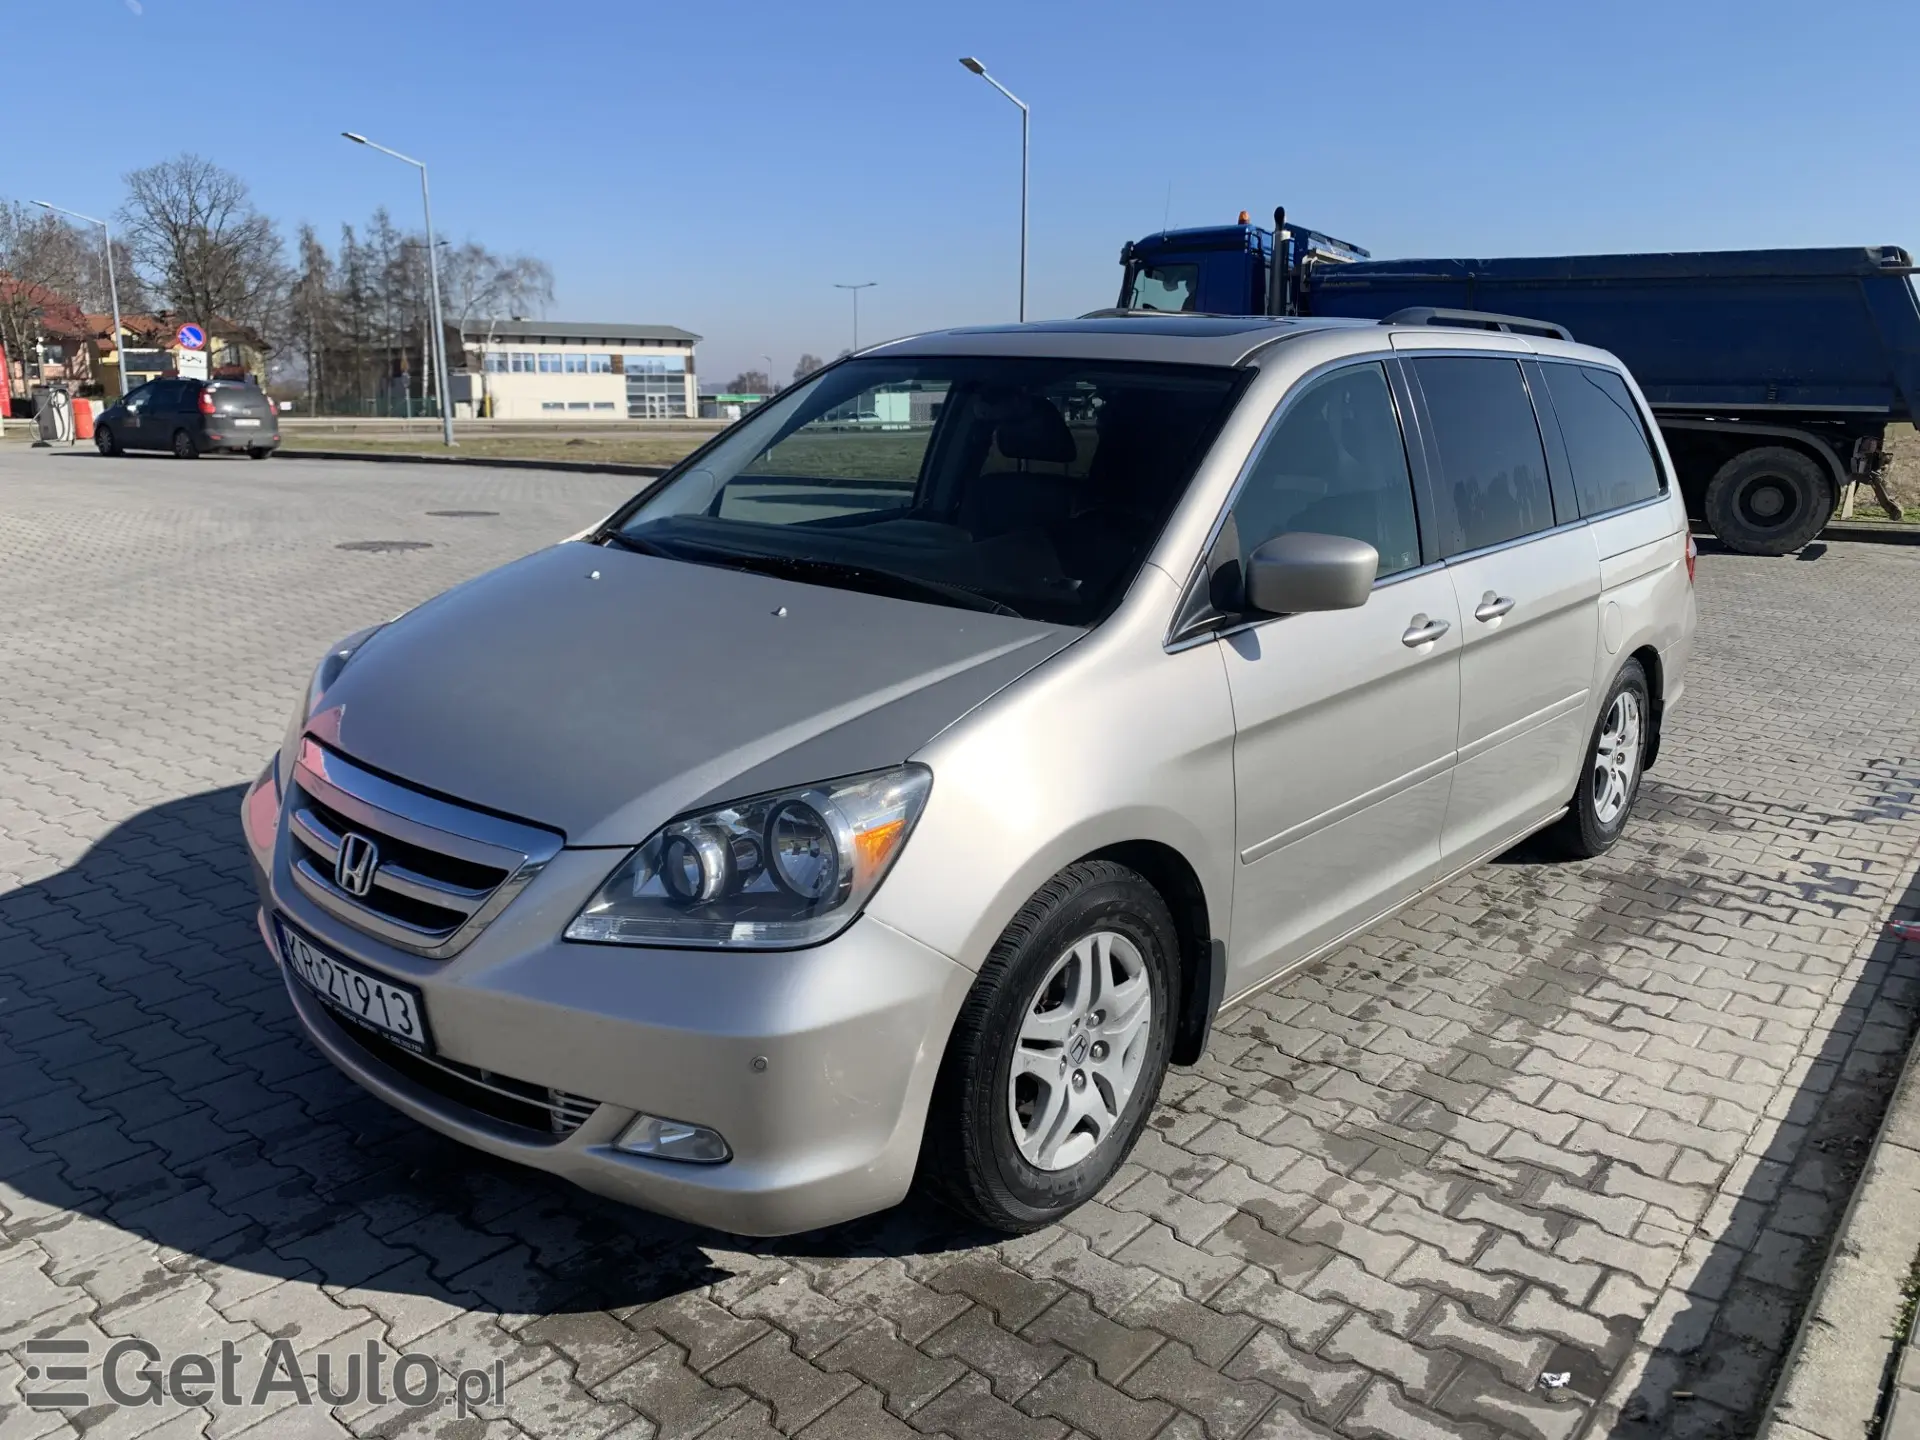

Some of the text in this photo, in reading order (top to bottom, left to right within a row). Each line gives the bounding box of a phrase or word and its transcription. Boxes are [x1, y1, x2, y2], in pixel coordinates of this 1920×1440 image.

[338, 833, 375, 894] H
[285, 931, 319, 986] KR
[321, 957, 413, 1035] 2T913
